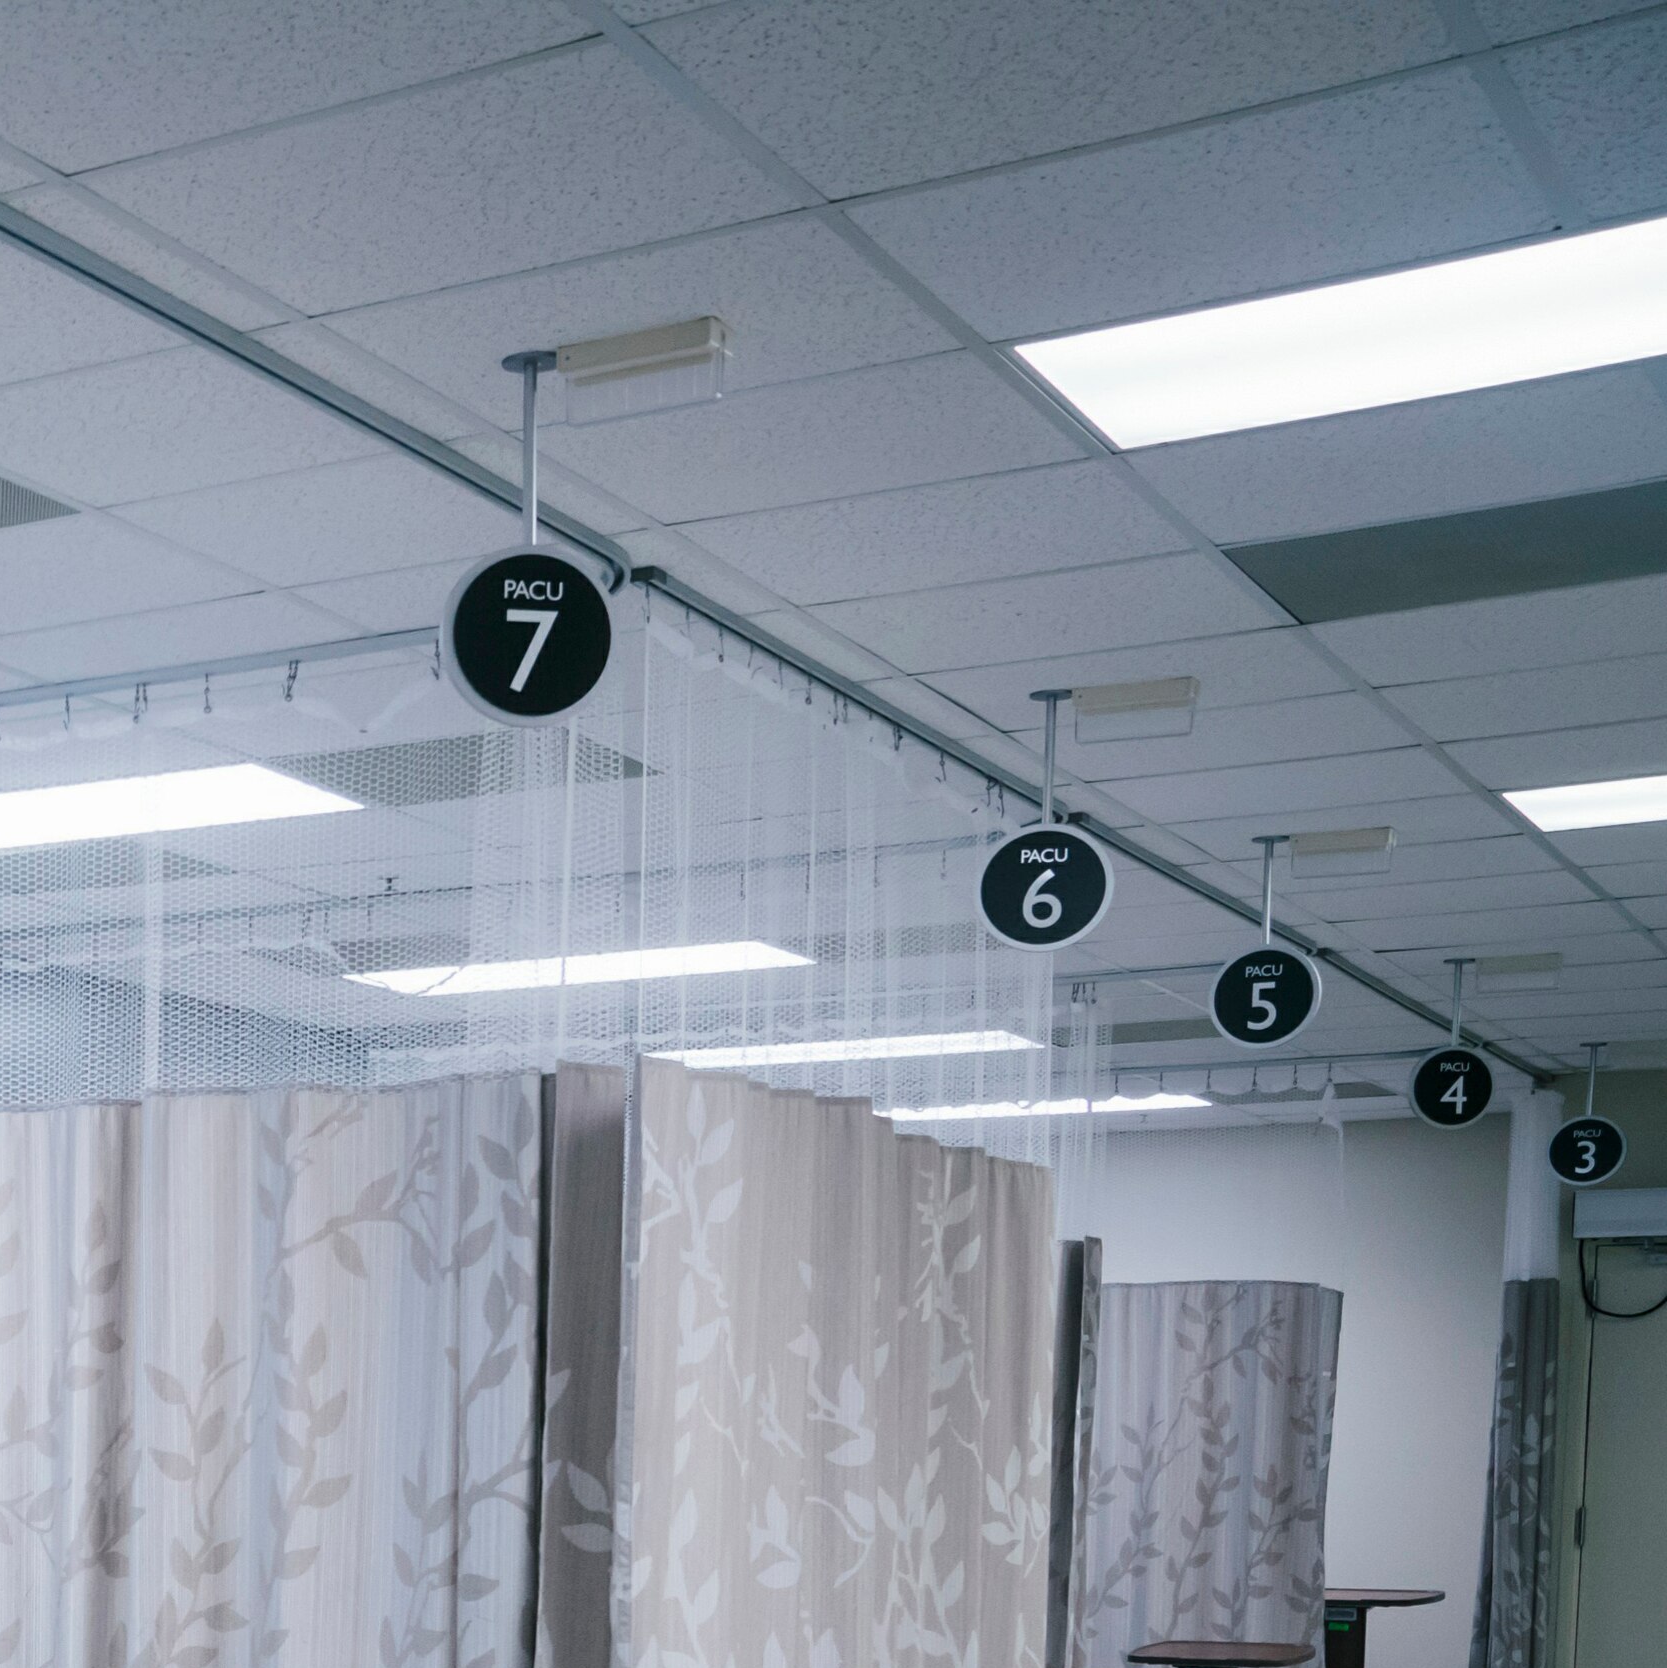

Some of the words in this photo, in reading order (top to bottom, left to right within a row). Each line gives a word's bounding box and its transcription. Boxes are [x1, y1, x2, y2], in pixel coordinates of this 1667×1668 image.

[504, 579, 564, 601] PACU
[506, 609, 559, 692] 7
[1020, 848, 1068, 864] PACU
[1022, 869, 1062, 928] 6
[1245, 964, 1283, 978] PACU
[1247, 981, 1277, 1031] 5
[1440, 1062, 1470, 1073] PACU
[1440, 1075, 1467, 1114] 4
[1573, 1128, 1601, 1138] PACU
[1574, 1140, 1595, 1174] 3
